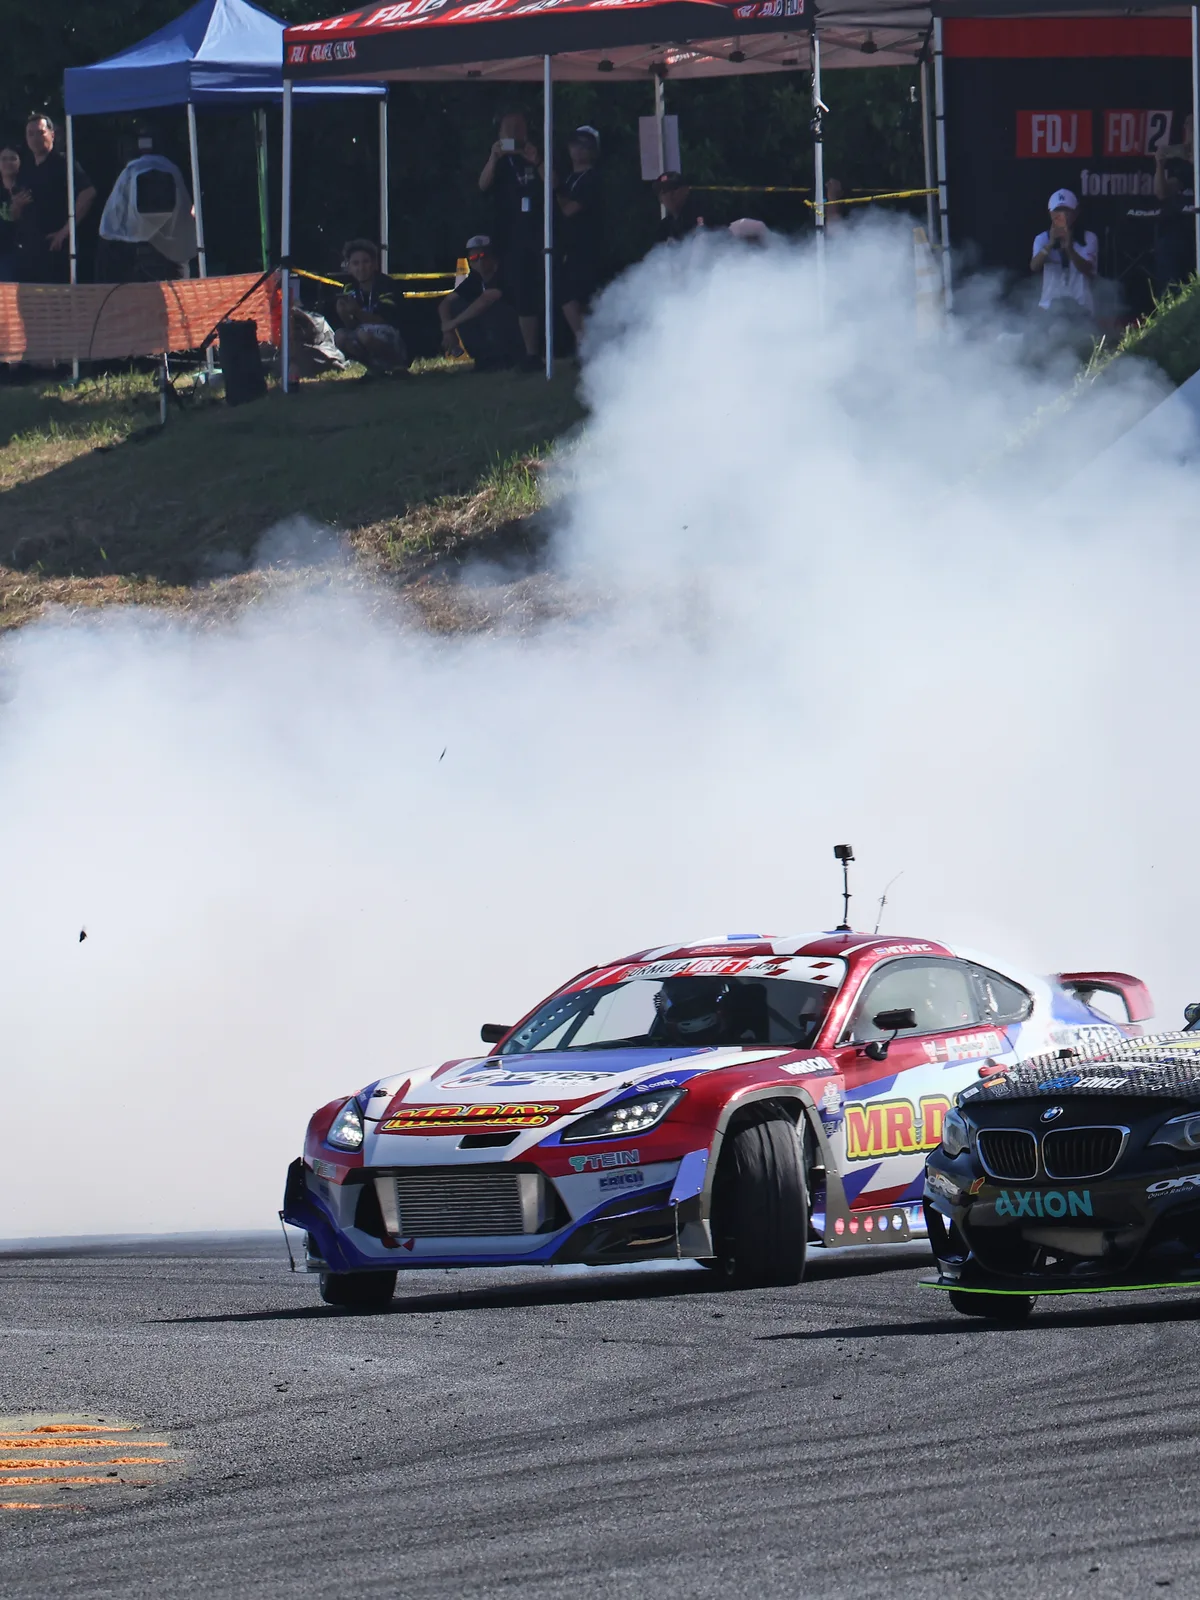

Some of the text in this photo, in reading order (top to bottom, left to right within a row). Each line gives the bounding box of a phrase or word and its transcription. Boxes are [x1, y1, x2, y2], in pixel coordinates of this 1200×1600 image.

[1031, 113, 1078, 154] FDJ
[617, 960, 692, 980] FORMULA
[688, 958, 750, 974] DRIFT
[587, 1149, 640, 1170] TEIN
[995, 1189, 1094, 1218] AXION
